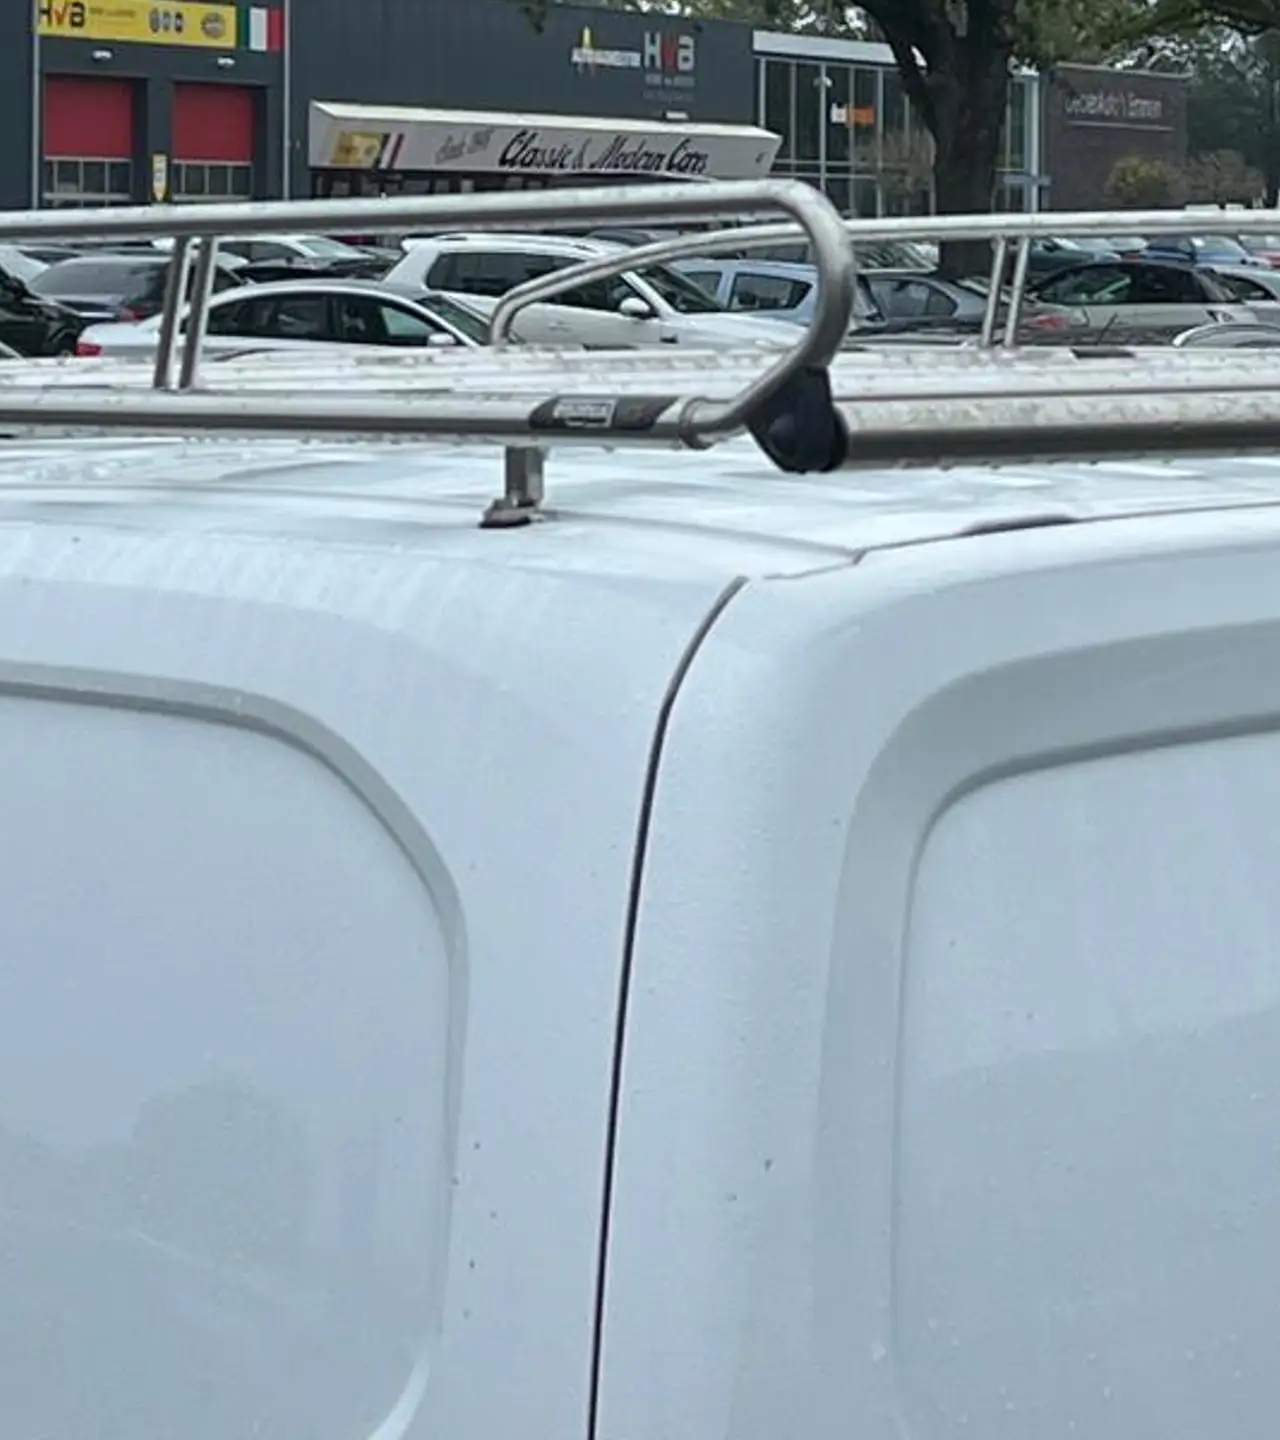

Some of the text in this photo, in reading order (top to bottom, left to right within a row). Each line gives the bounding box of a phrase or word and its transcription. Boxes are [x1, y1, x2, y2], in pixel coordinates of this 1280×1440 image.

[499, 129, 571, 169] Classic
[589, 134, 665, 173] Modern
[665, 137, 709, 174] Cars
